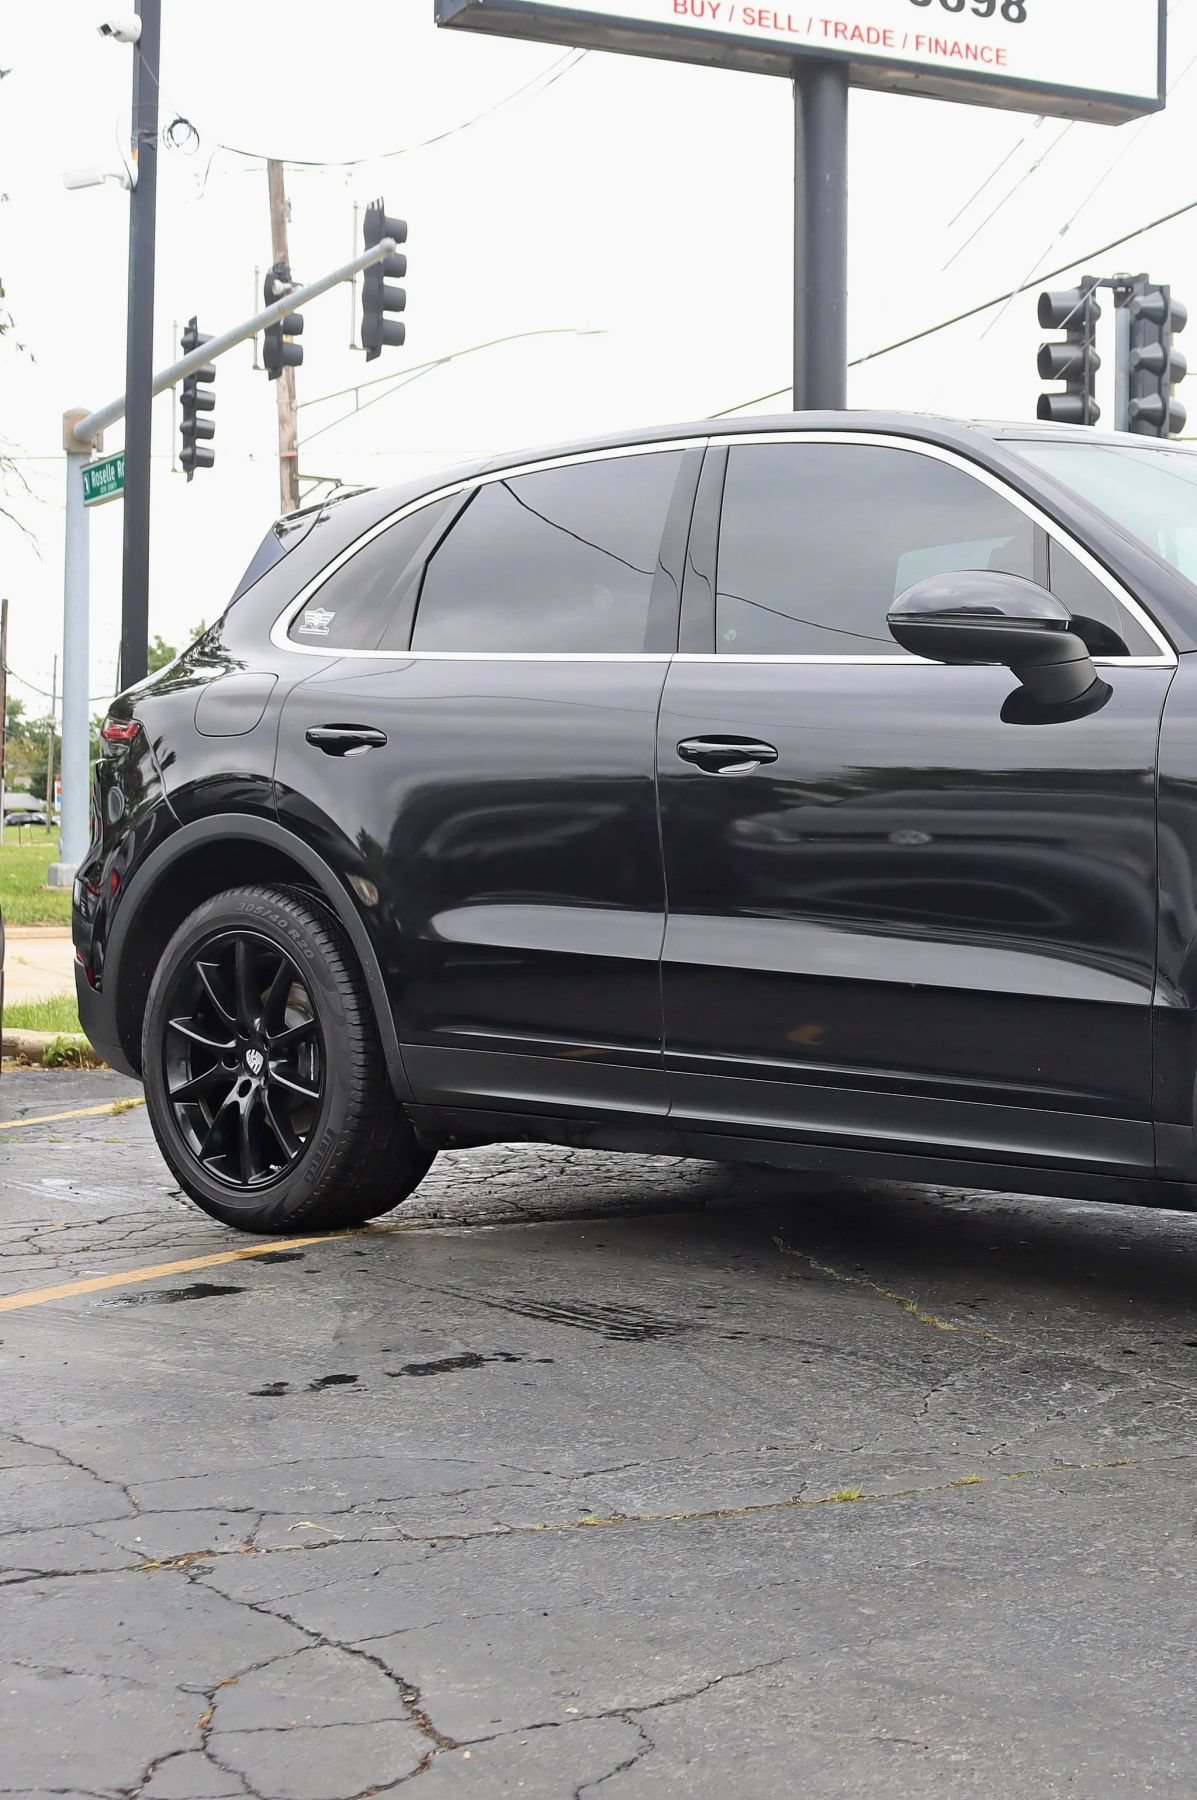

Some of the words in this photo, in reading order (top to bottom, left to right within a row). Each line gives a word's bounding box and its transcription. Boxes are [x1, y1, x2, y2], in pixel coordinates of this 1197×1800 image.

[672, 0, 721, 20] BUY
[742, 6, 800, 33] SELL
[820, 18, 896, 48] TRADE
[914, 34, 1008, 66] FINANCE
[91, 463, 115, 488] Roselle
[235, 902, 288, 928] 305/40
[287, 929, 314, 959] R20
